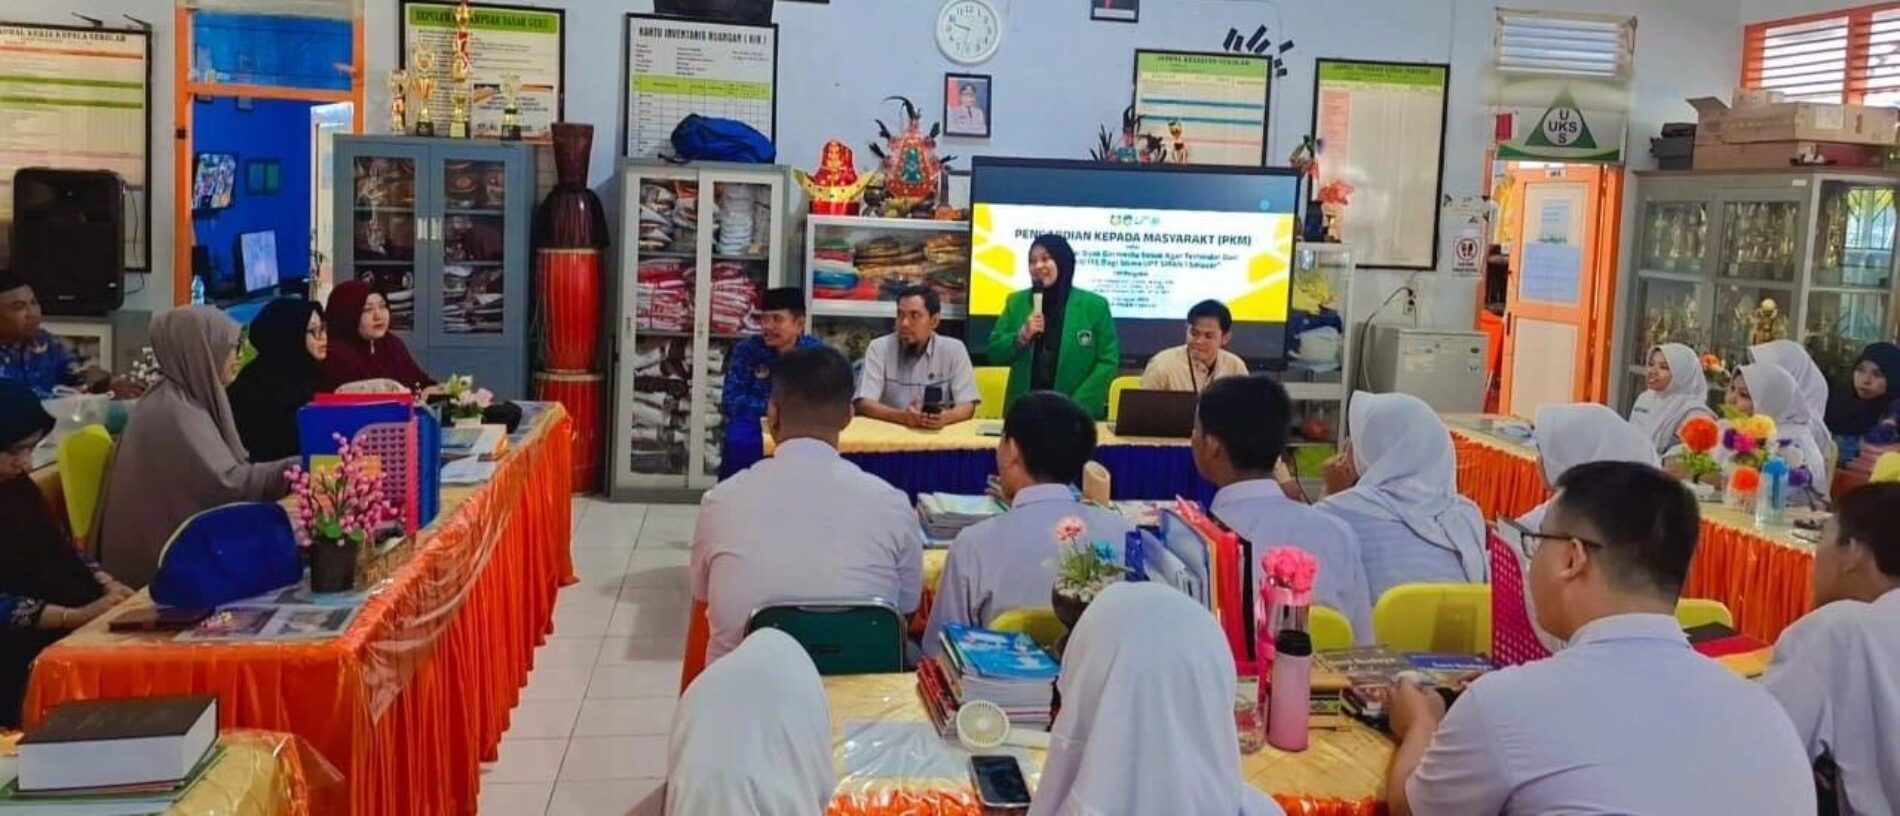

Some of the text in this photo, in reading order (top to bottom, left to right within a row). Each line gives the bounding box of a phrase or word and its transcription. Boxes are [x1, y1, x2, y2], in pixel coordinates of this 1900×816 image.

[639, 26, 662, 38] KARTU
[1548, 121, 1577, 133] UKS
[1094, 231, 1141, 243] KEPADA
[1143, 232, 1215, 245] MASYARAKT
[1217, 235, 1252, 247] (PKM)
